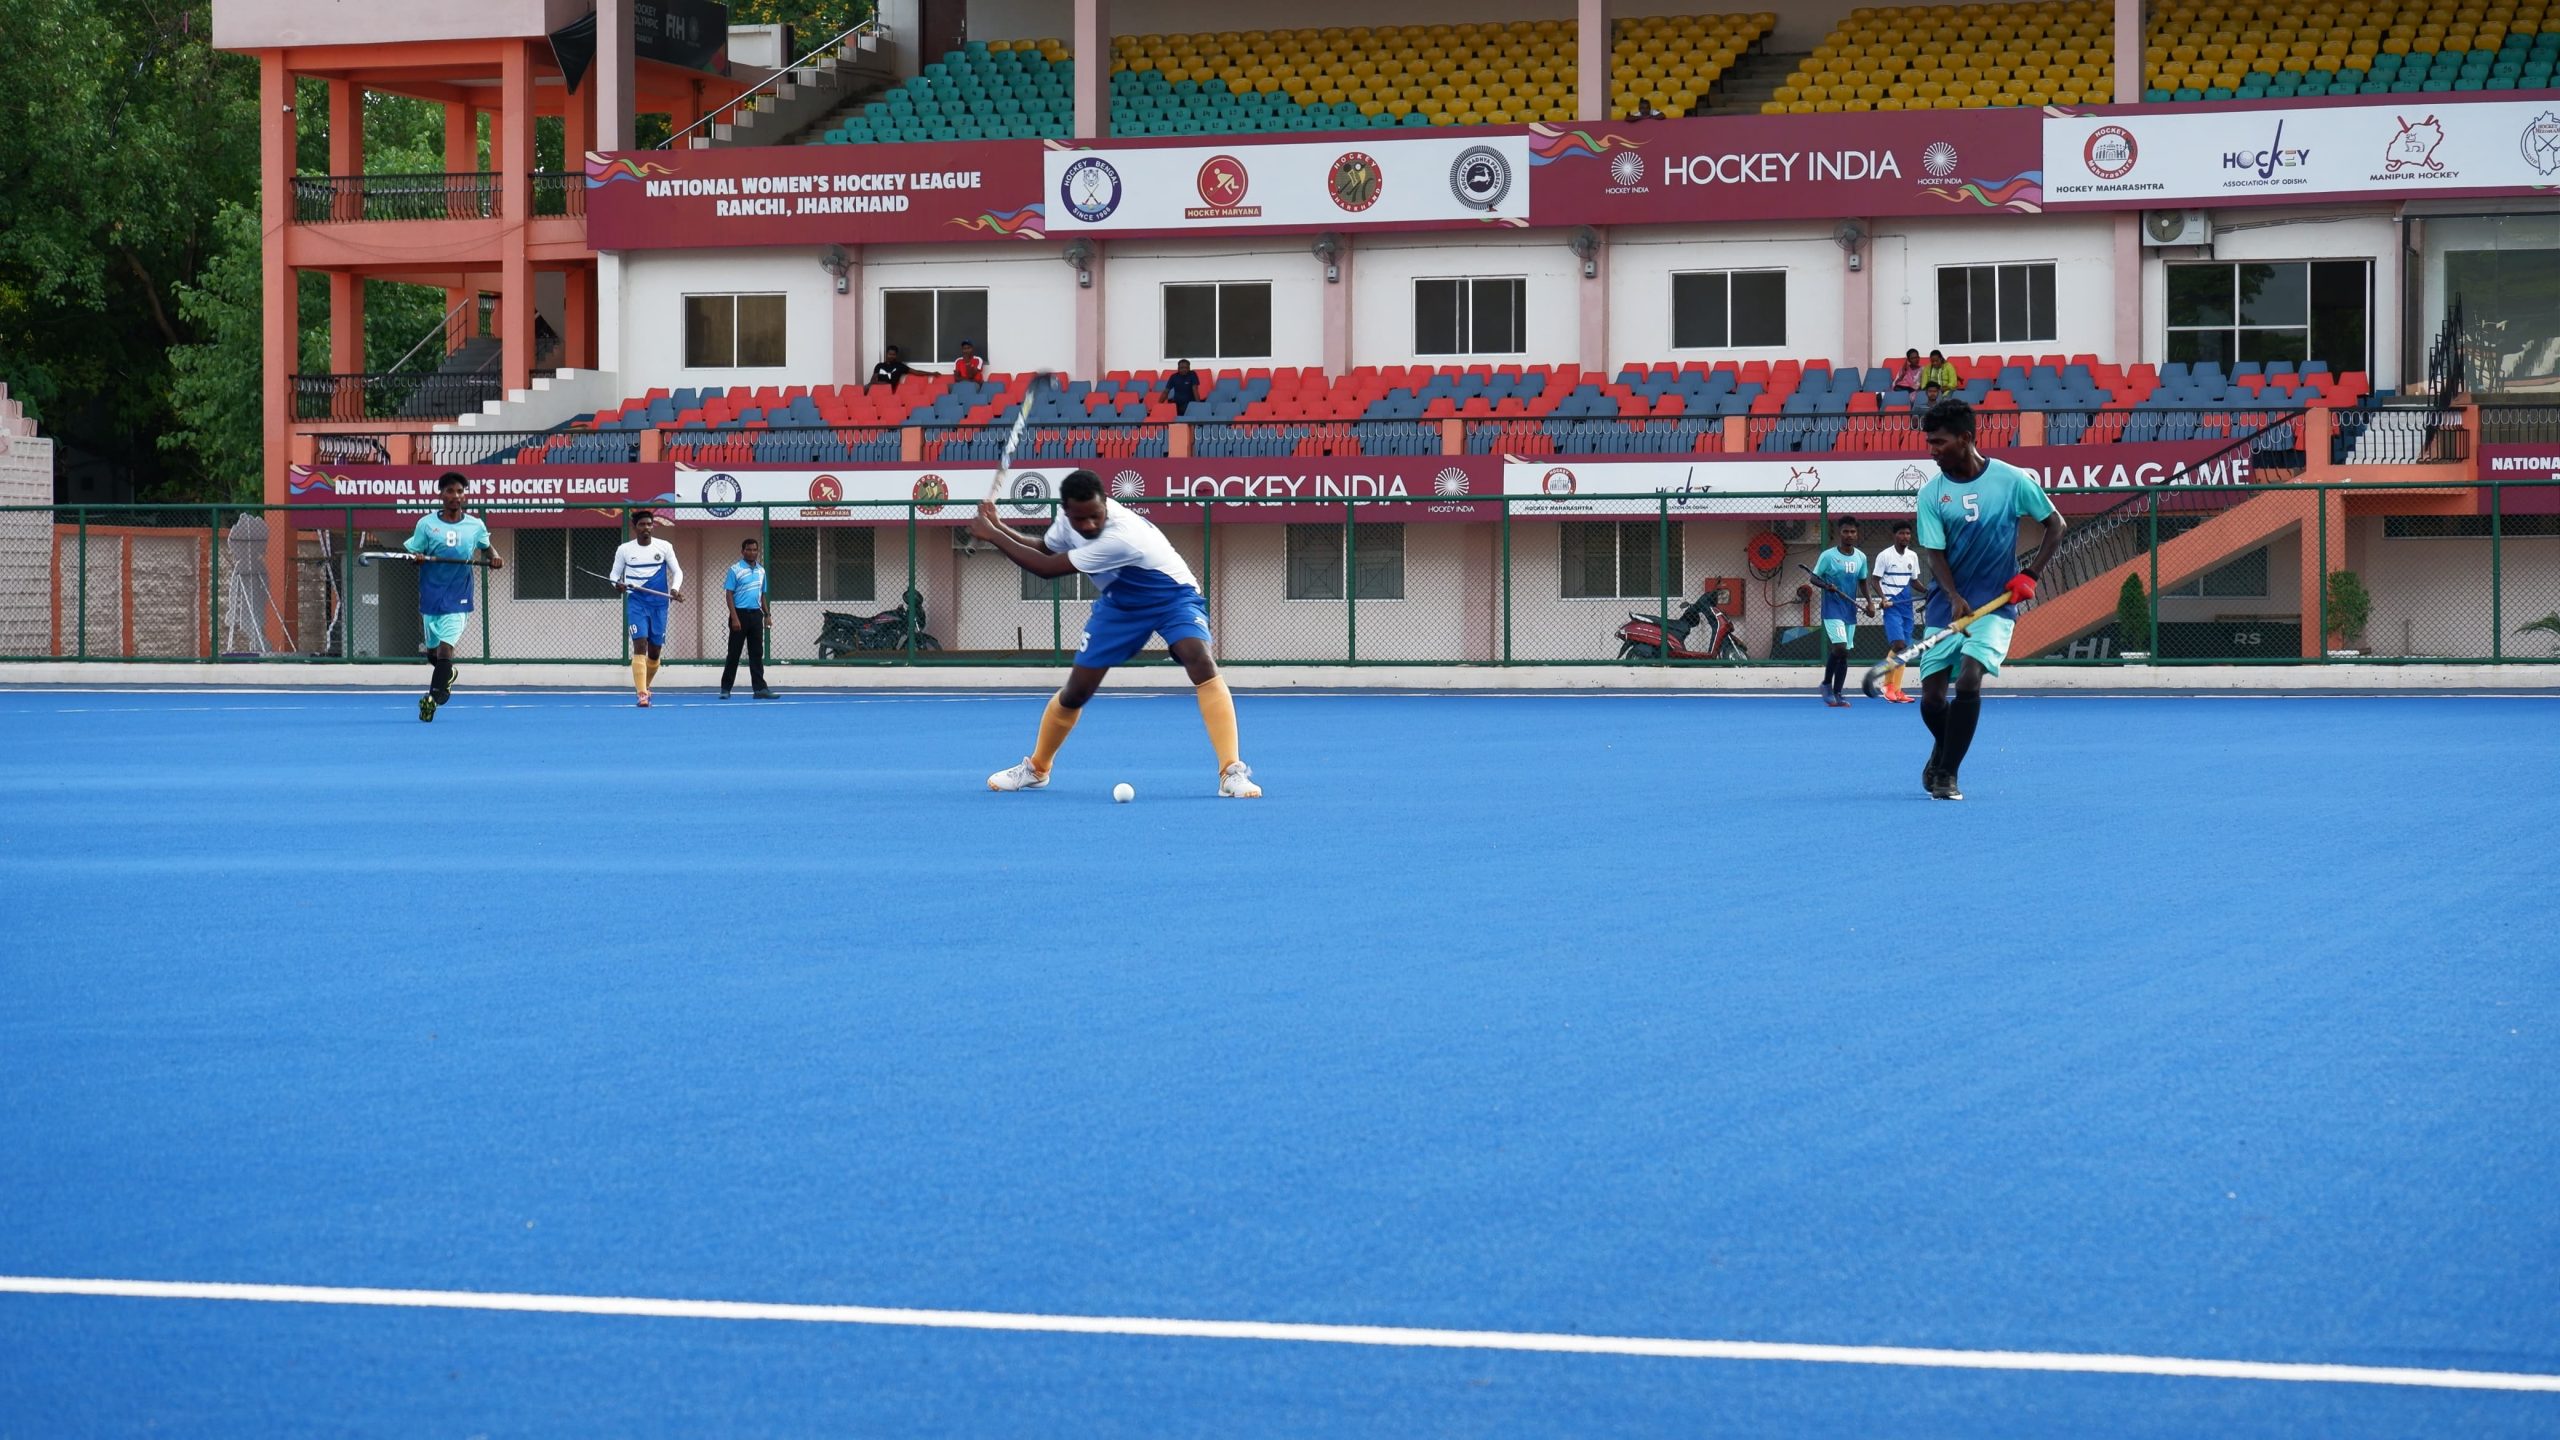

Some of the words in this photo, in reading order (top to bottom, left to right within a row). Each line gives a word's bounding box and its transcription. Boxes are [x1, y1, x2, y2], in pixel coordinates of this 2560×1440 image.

[2095, 128, 2127, 137] HOCKEY
[1334, 153, 1376, 169] HOCKEY
[1665, 152, 1799, 185] HOCKEY
[1809, 150, 1901, 180] INDIA
[2088, 159, 2132, 178] Maharashtra
[1064, 160, 1087, 187] HOCKEY
[1095, 160, 1119, 187] BENGAL
[1460, 166, 1469, 190] HOCKEY
[1466, 157, 1491, 167] MADHYA
[1490, 161, 1501, 190] PRADESH
[2370, 173, 2415, 181] MANIPUR
[2419, 171, 2459, 179] HOCKEY
[646, 178, 738, 197] NATIONAL
[742, 175, 830, 194] WOMEN'S
[834, 173, 905, 192] HOCKEY
[911, 171, 982, 190] LEAGUE
[2056, 185, 2093, 193] HOCKEY
[2096, 183, 2165, 192] MAHARASHTRA
[2223, 179, 2268, 187] ASSOCIATION
[717, 198, 792, 217] RANCHI,
[796, 195, 909, 215] JHARKHAND
[1331, 188, 1381, 211] JHARKHAND
[1072, 207, 1094, 221] SINCE
[1187, 209, 1220, 217] HOCKEY
[1222, 208, 1259, 216] HARYANA
[2492, 457, 2560, 470] NATIONA
[335, 479, 416, 495] NATIONAL
[499, 479, 563, 494] HOCKEY
[567, 478, 629, 493] LEAGUE
[1167, 475, 1306, 507] HOCKEY
[1315, 475, 1411, 506] INDIA
[1428, 505, 1454, 513] HOCKEY
[1962, 494, 1980, 522] 5
[1845, 562, 1856, 574] 10
